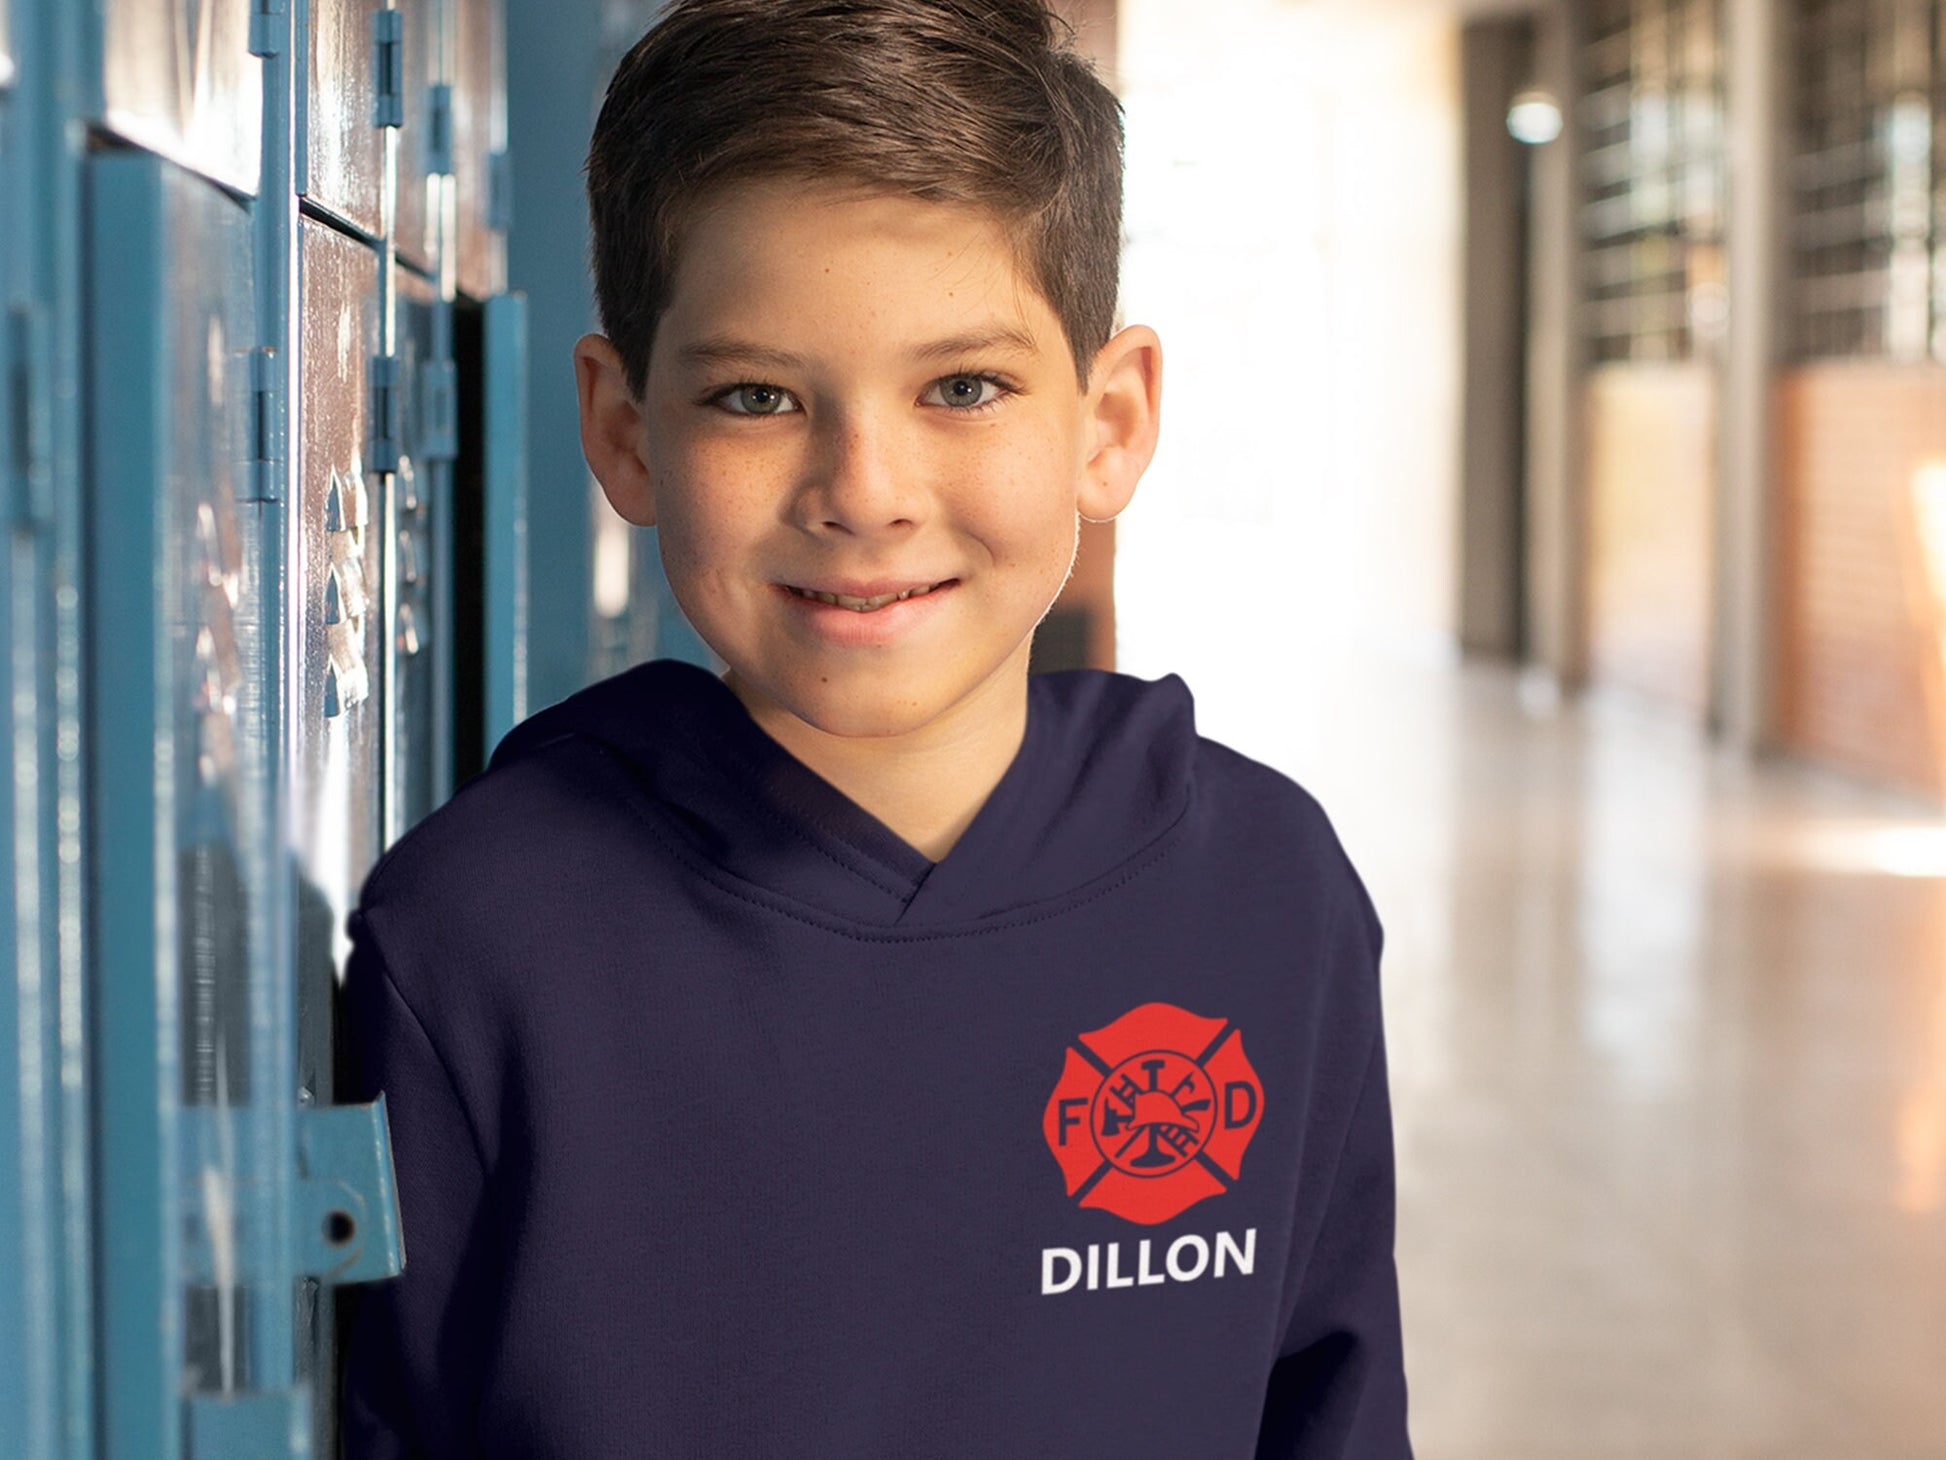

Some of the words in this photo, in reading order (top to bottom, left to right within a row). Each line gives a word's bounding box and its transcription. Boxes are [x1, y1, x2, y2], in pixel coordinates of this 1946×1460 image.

[1058, 1097, 1089, 1146] F
[1224, 1080, 1257, 1130] D
[1041, 1228, 1257, 1295] DILLON
